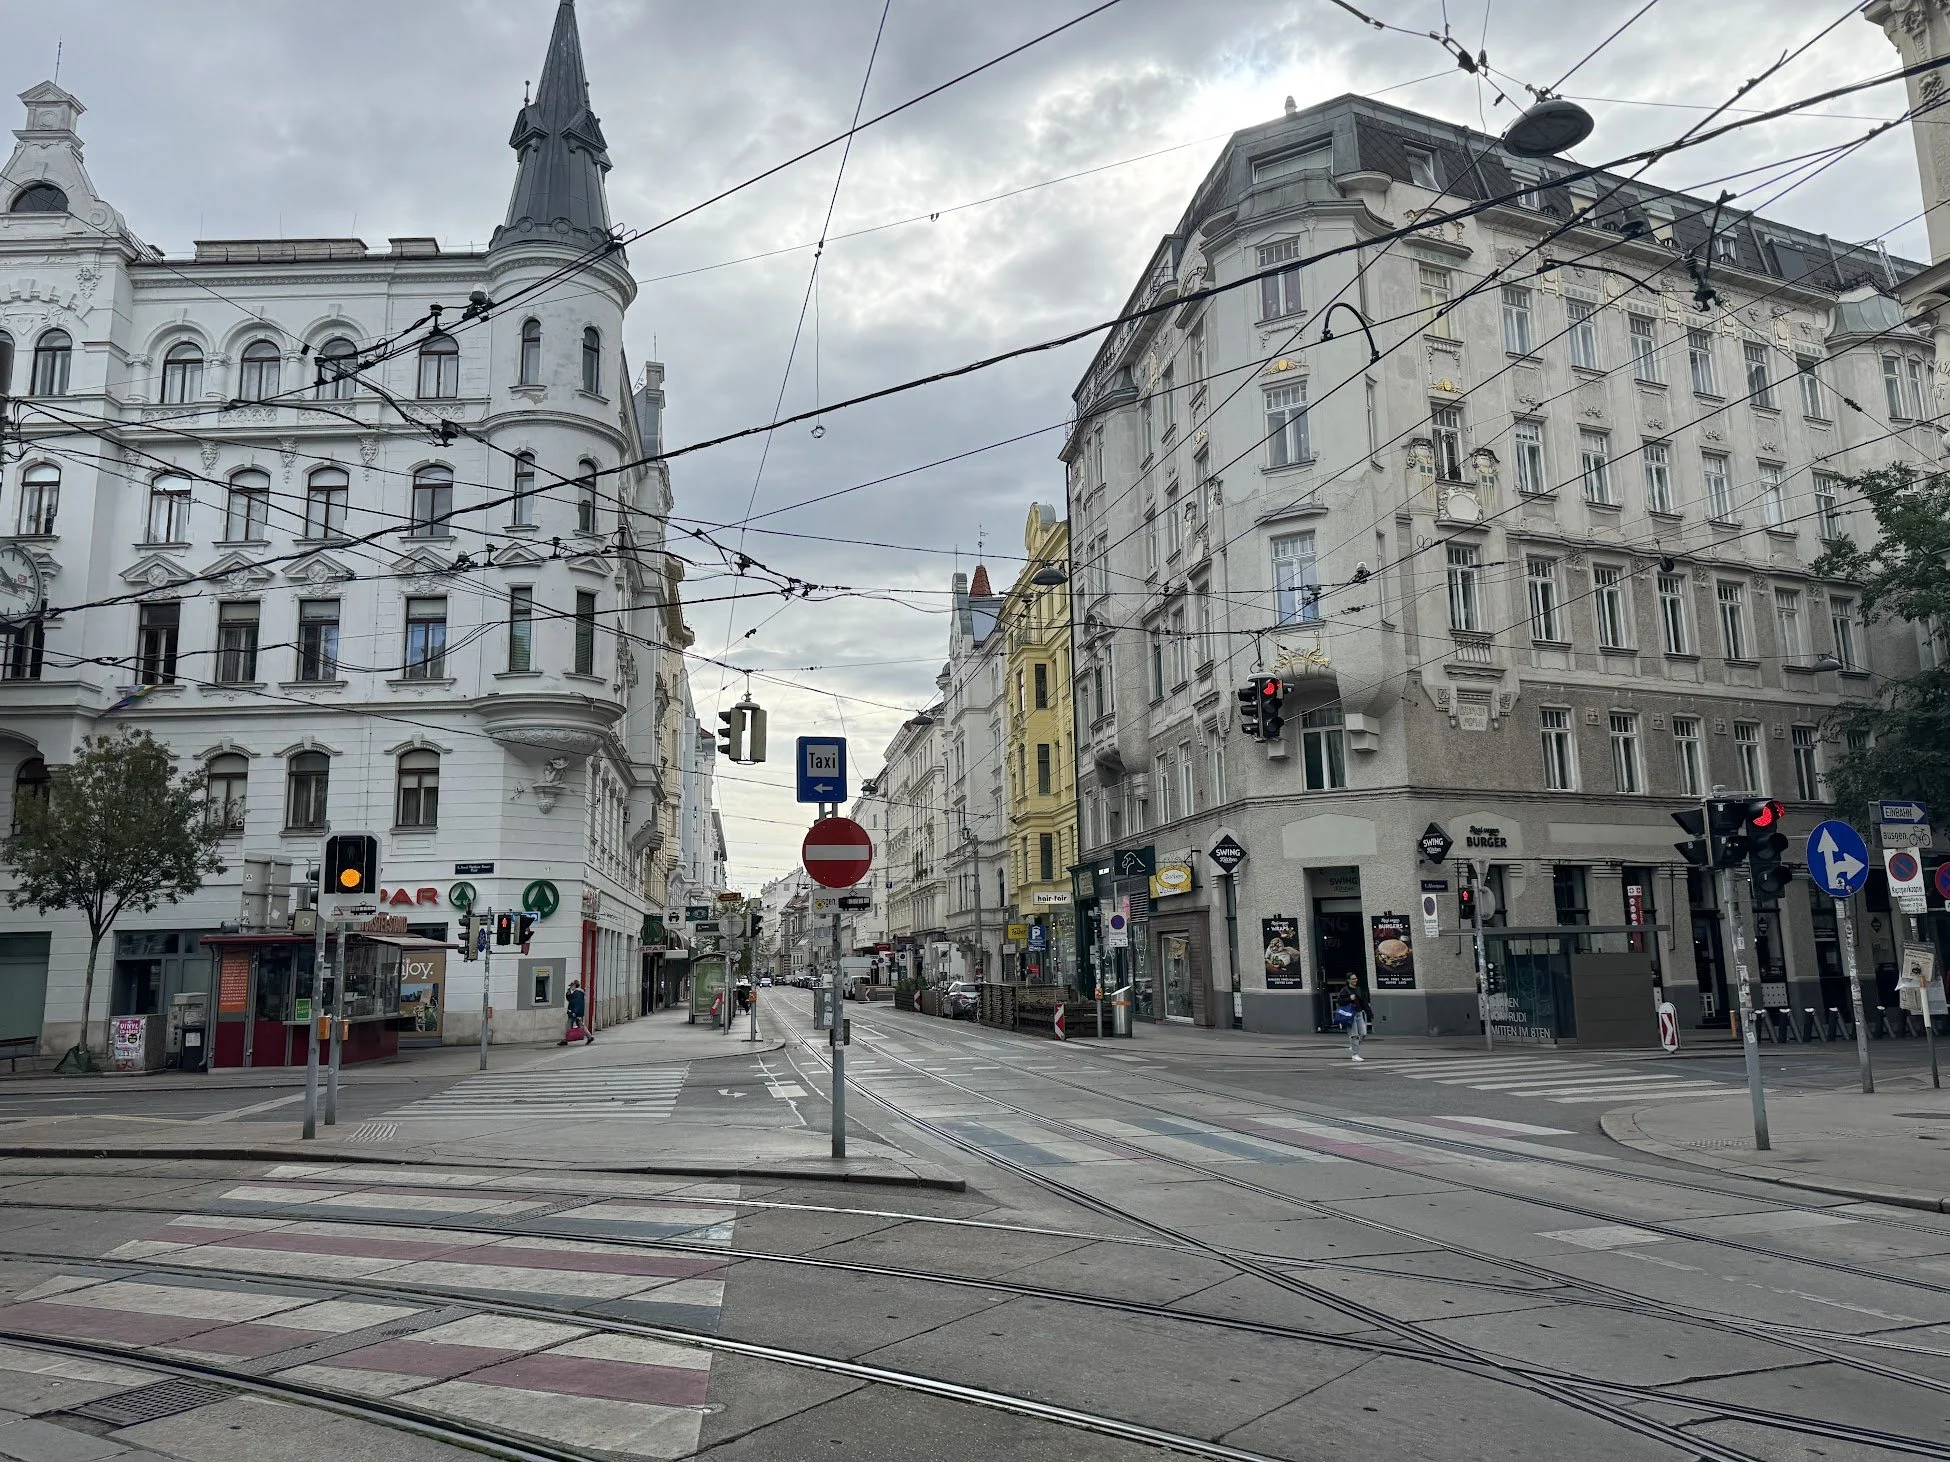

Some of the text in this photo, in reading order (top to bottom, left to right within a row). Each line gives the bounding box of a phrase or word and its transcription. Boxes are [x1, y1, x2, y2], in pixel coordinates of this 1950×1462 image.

[809, 752, 836, 769] Taxi
[1885, 807, 1912, 818] EINBAHN
[1422, 837, 1444, 848] SWING
[1466, 836, 1507, 848] BURGER
[1883, 831, 1909, 843] ausgen.
[1215, 848, 1241, 857] SWING
[1329, 876, 1358, 886] SWING
[1508, 1011, 1527, 1023] RUDI
[1491, 1025, 1517, 1036] MITTEN
[1519, 1026, 1529, 1037] IM
